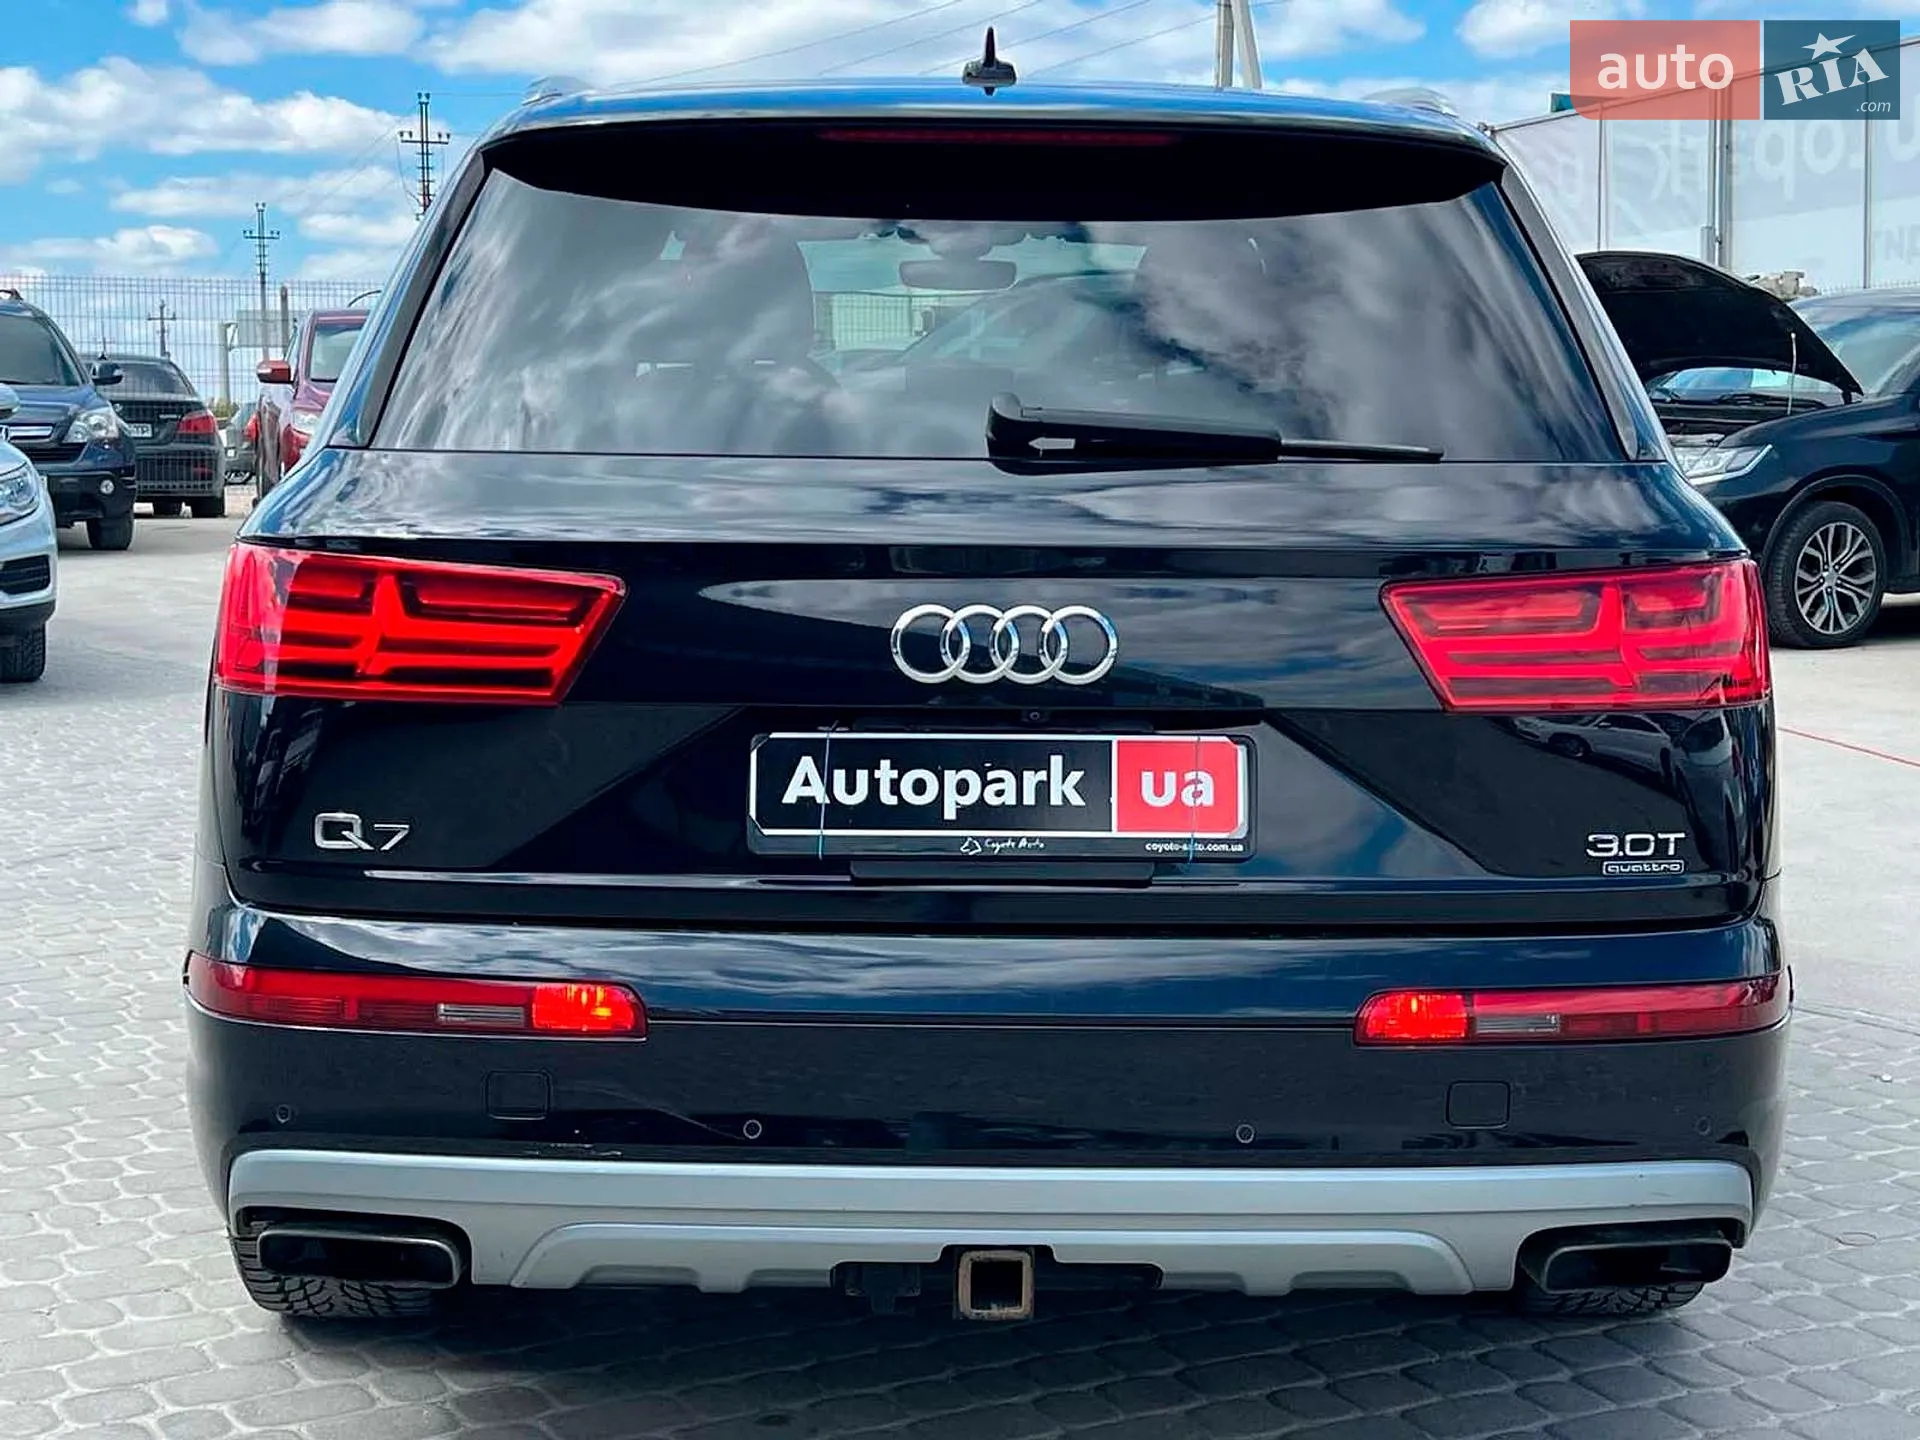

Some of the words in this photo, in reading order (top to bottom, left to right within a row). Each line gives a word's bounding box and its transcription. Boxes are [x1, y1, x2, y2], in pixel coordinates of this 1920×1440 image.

[781, 754, 1085, 820] Autopark
[1140, 770, 1215, 808] ua
[315, 812, 410, 851] Q7
[1586, 832, 1686, 857] 3.0T
[1607, 863, 1681, 873] quattro
